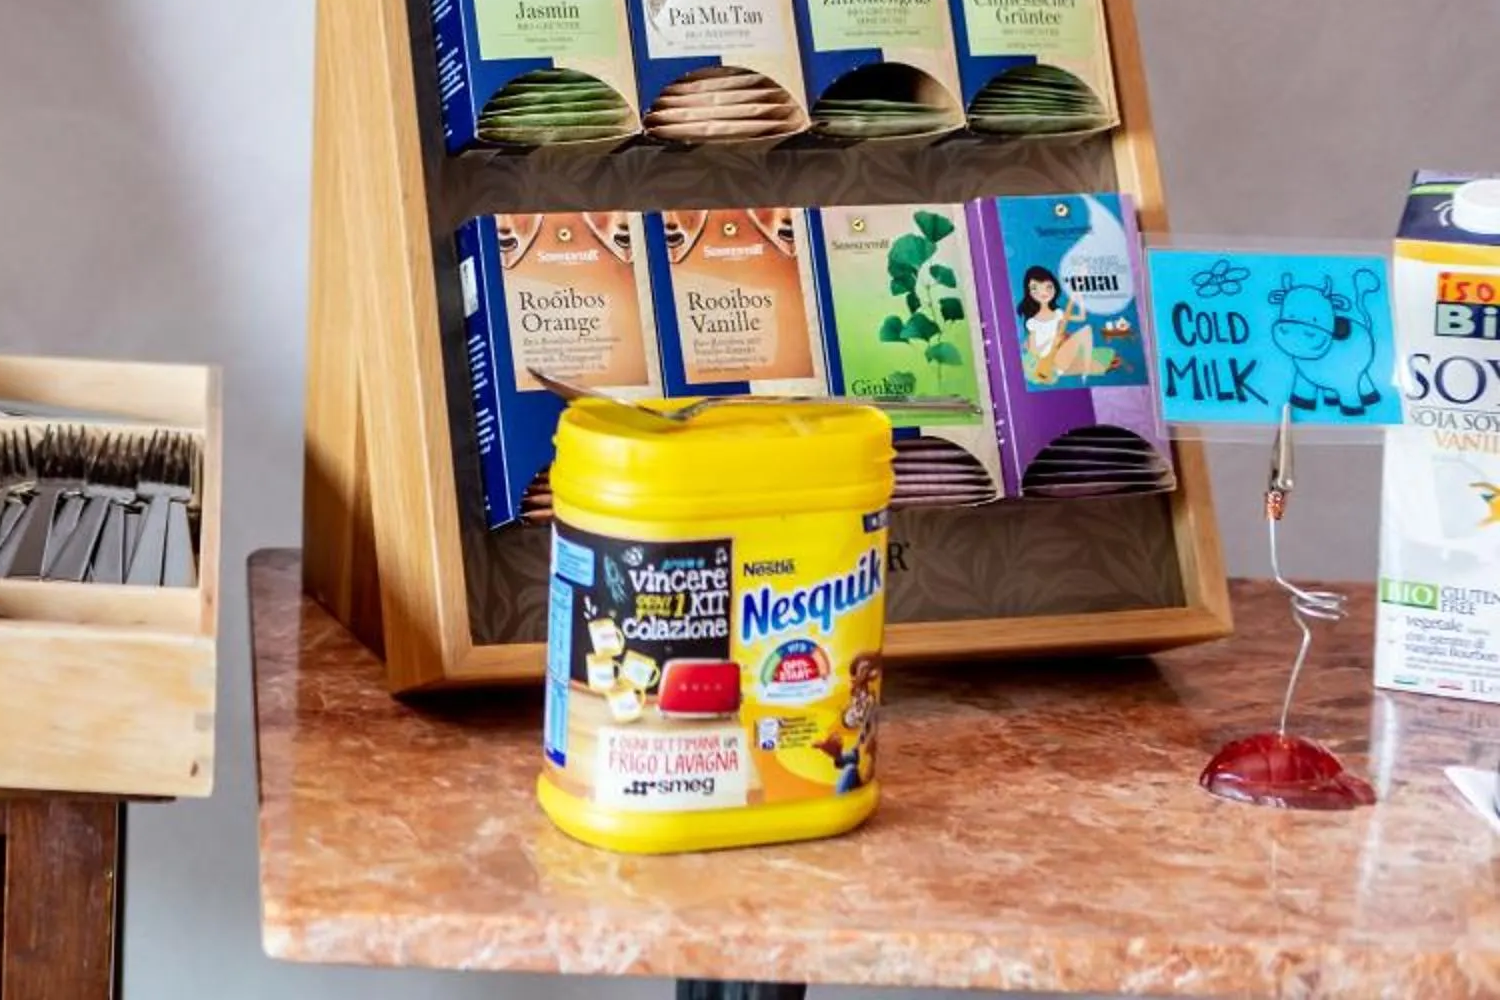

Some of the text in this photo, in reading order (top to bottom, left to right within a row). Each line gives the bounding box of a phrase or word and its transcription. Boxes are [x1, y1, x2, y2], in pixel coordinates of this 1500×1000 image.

[515, 1, 580, 20] Jasmin
[668, 4, 764, 27] Pai Mu Tan
[995, 7, 1063, 25] Grüntee
[687, 288, 773, 311] Rooibos
[521, 313, 601, 336] Orange
[691, 313, 762, 333] Vanille
[1172, 302, 1249, 347] COLD
[1165, 356, 1268, 405] MILK
[628, 564, 728, 592] vincere
[690, 591, 729, 617] KIT
[743, 549, 881, 640] Nesquik
[609, 750, 739, 774] FRIGO LAVAGNA
[657, 776, 715, 794] smeg
